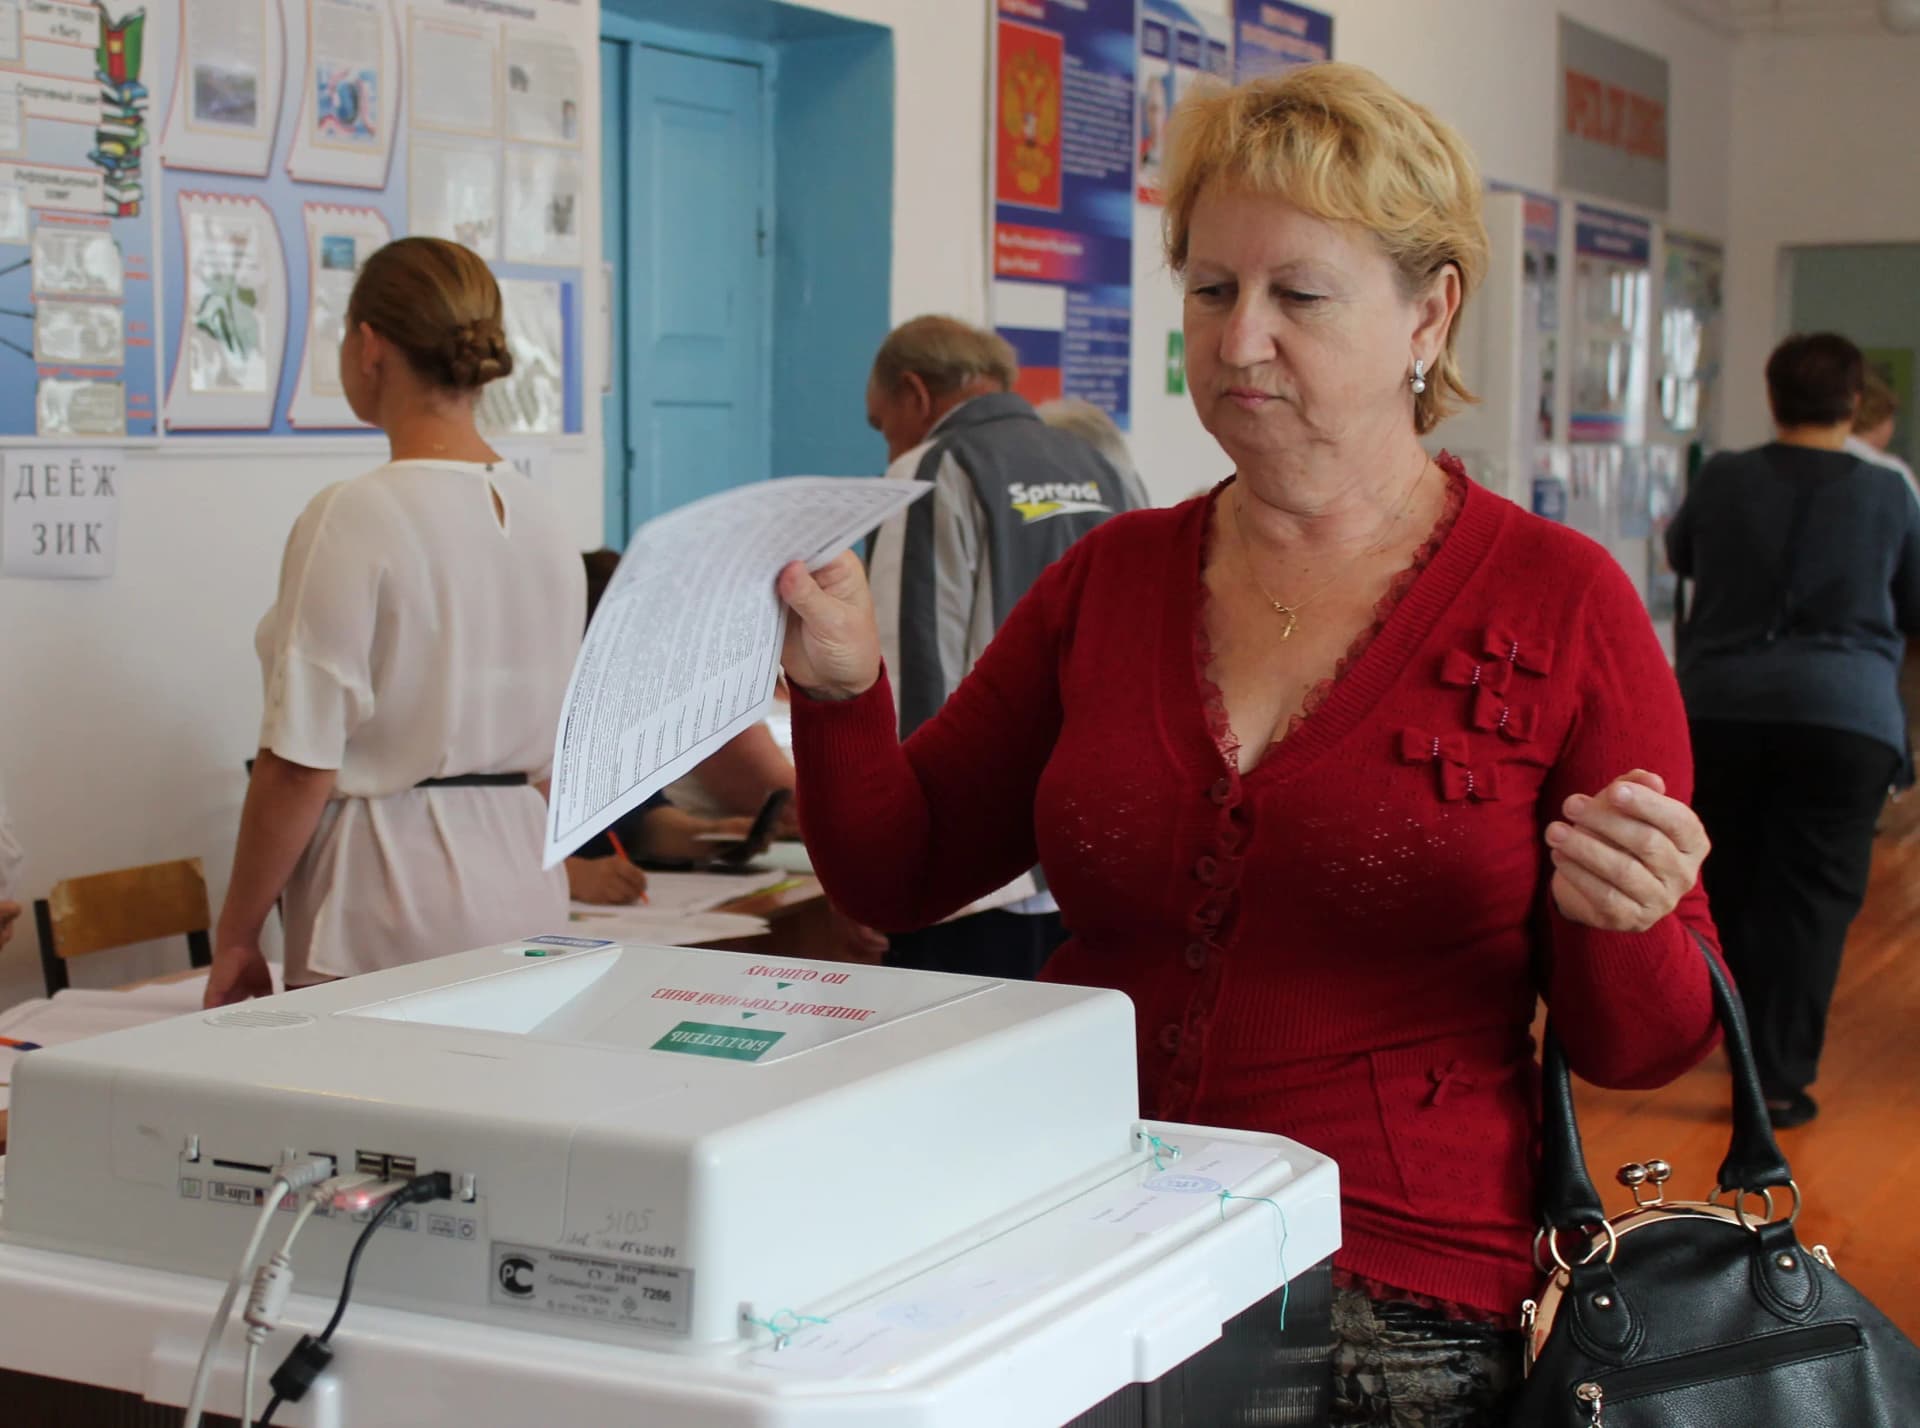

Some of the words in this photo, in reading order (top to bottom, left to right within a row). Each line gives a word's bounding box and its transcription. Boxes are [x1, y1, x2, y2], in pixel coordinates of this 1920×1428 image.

[14, 459, 117, 502] ДЕЁЖ
[31, 522, 104, 556] ЗИК
[743, 965, 818, 982] ОДНОМУ
[820, 972, 851, 985] ПО
[651, 988, 695, 1003] ВНИЗ
[669, 1030, 770, 1052] БЮЛЛЕТЕНЬ
